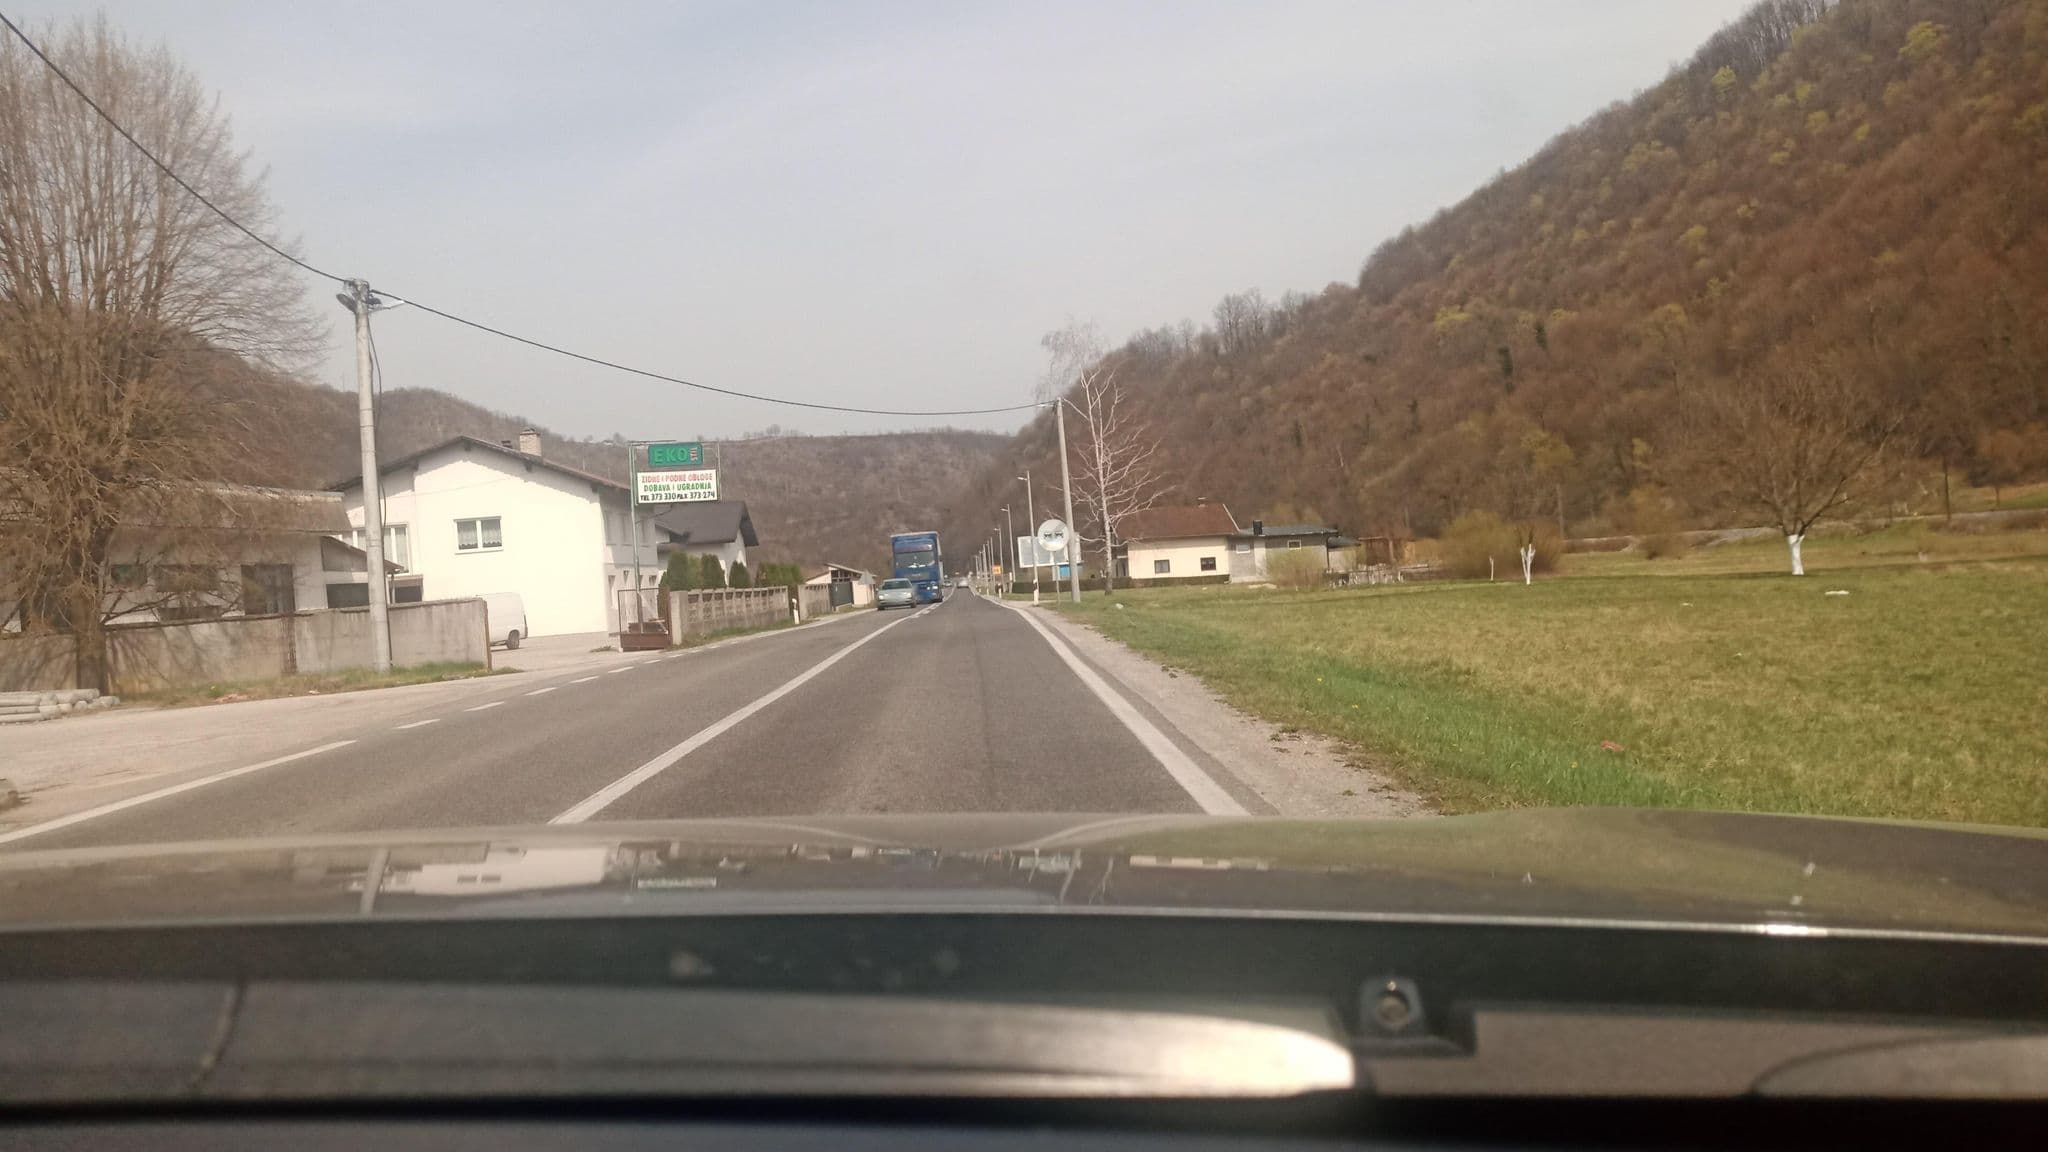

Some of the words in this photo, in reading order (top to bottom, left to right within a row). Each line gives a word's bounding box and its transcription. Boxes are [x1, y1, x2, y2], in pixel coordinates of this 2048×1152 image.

[654, 447, 688, 463] EKO
[665, 474, 686, 482] PODNE
[644, 484, 670, 492] DOBAVA
[651, 493, 663, 501] 373
[664, 492, 676, 500] 330
